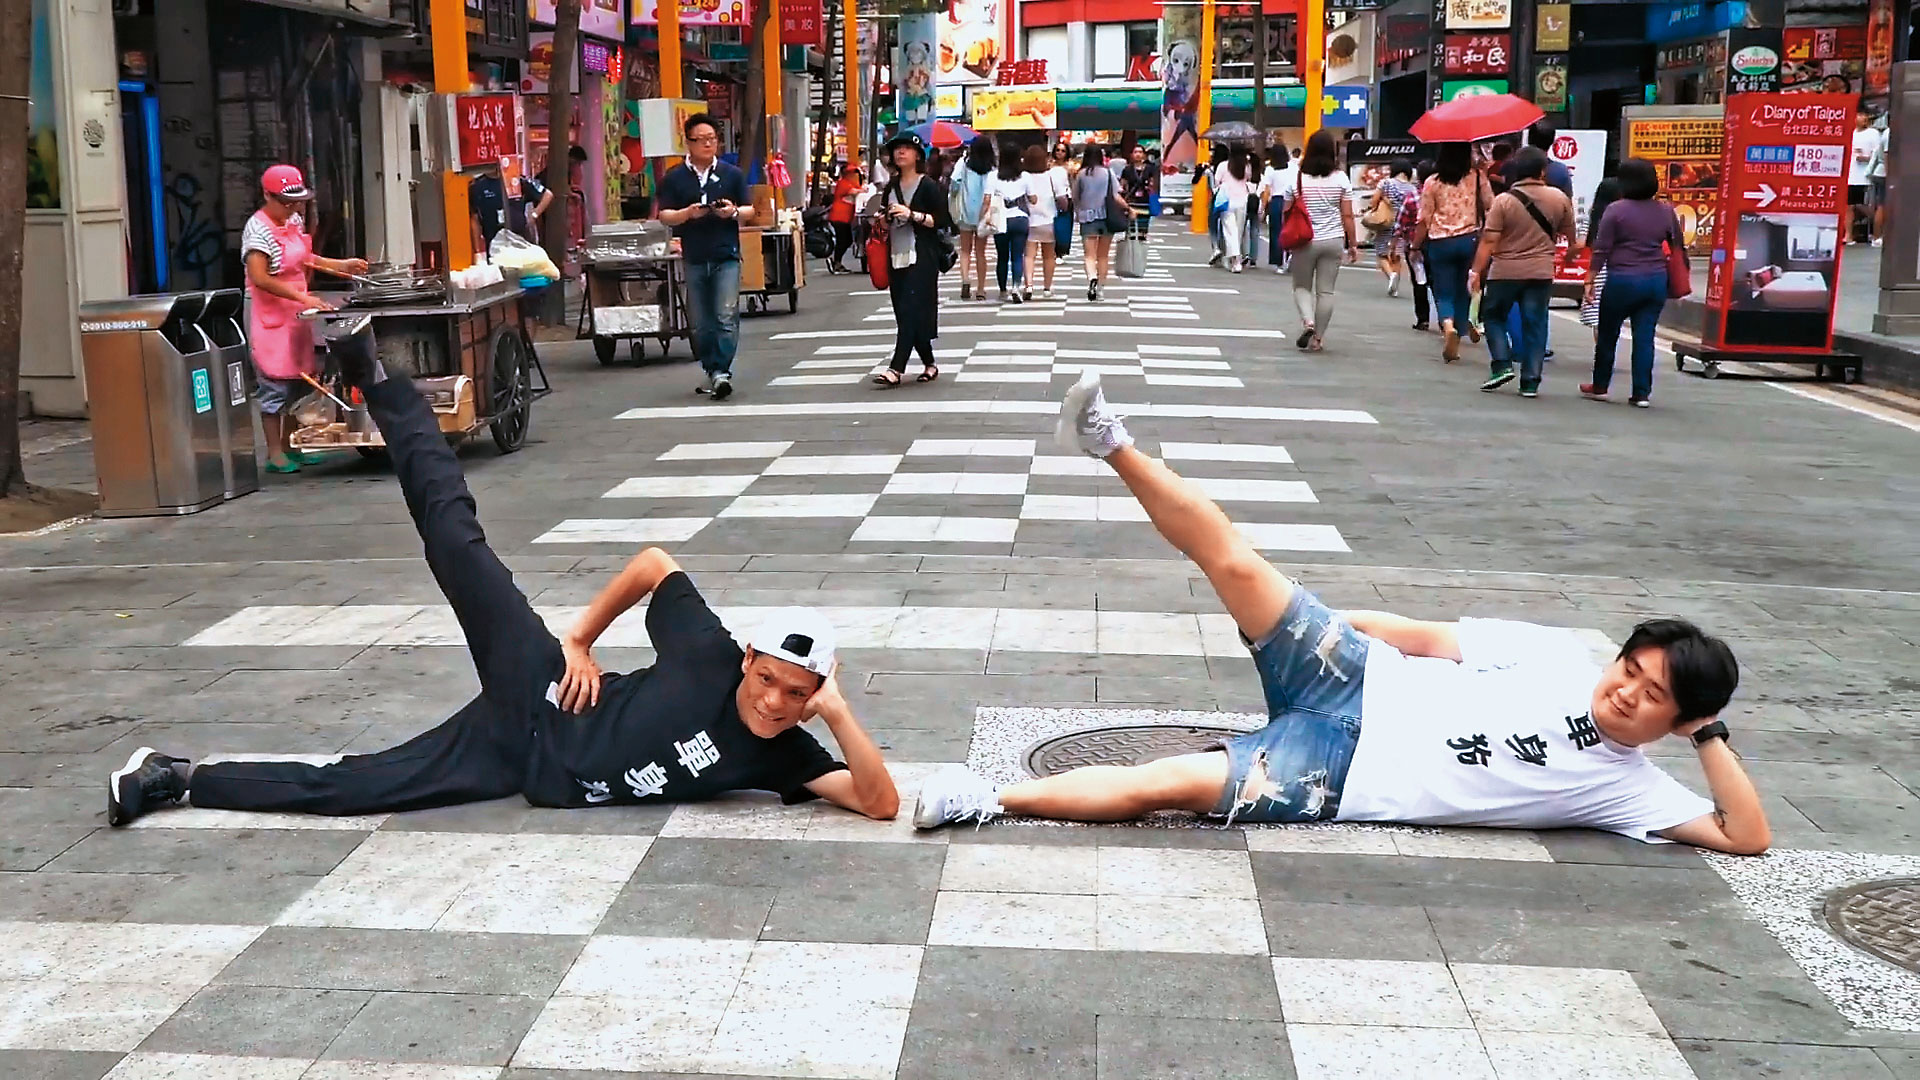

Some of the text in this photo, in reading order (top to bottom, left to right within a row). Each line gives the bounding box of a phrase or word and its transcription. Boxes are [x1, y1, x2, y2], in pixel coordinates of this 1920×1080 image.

[1462, 46, 1506, 66] 和民
[995, 59, 1048, 86] 肯德基
[1763, 105, 1846, 123] Diary of Taipei
[1389, 146, 1415, 154] PLAZA
[1797, 148, 1823, 160] 480
[1796, 160, 1821, 173] 休息
